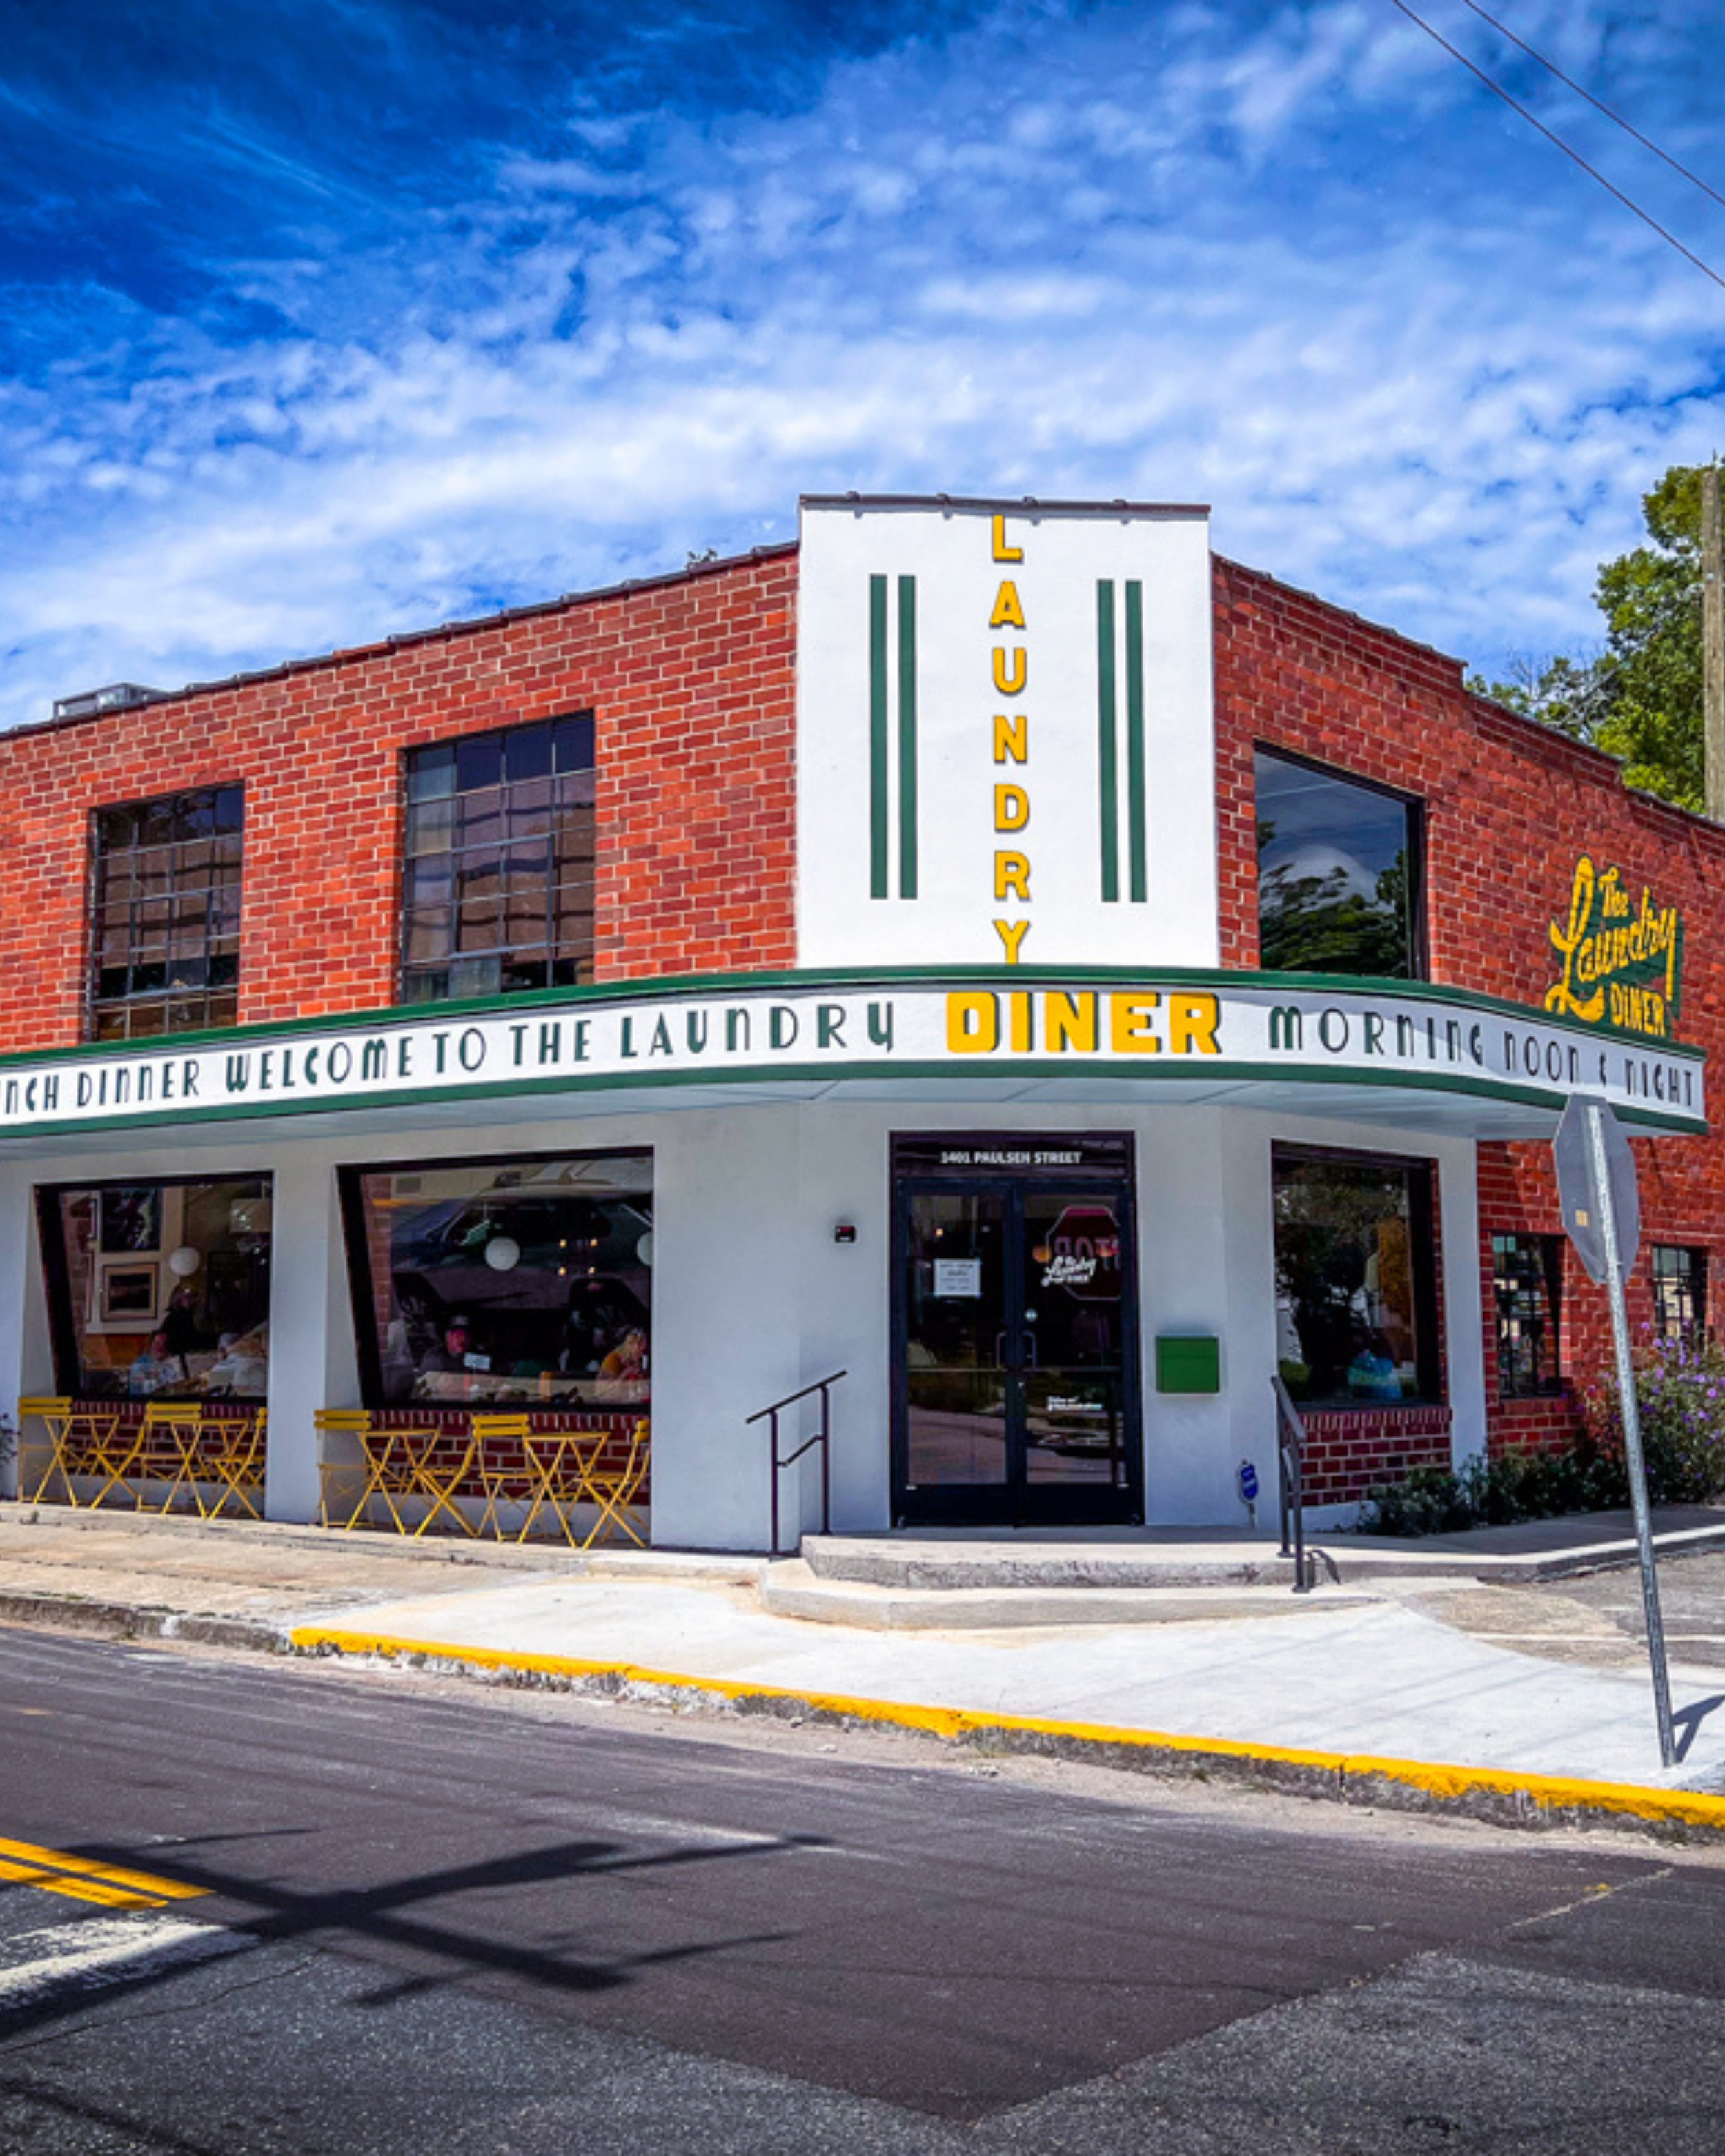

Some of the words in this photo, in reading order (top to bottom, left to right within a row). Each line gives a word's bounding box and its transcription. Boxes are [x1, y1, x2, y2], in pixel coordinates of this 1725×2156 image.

[989, 514, 1031, 964] LAUNDRY
[1597, 866, 1628, 917] The
[1544, 856, 1677, 1022] Laundry
[0, 1077, 59, 1114] NCH
[77, 1059, 200, 1108] DINNER
[226, 1036, 414, 1093] WELCOME
[432, 1027, 486, 1074] TO
[509, 1020, 592, 1065] THE
[620, 1001, 894, 1058] LAUNDRY
[946, 991, 1221, 1054] DINER
[1268, 1005, 1483, 1067] MORNING
[1504, 1031, 1579, 1085] NOON
[1625, 1058, 1692, 1106] NIGHT
[1610, 981, 1666, 1036] DINER
[974, 1151, 1031, 1164] PAULSEN
[1034, 1151, 1083, 1164] STREET
